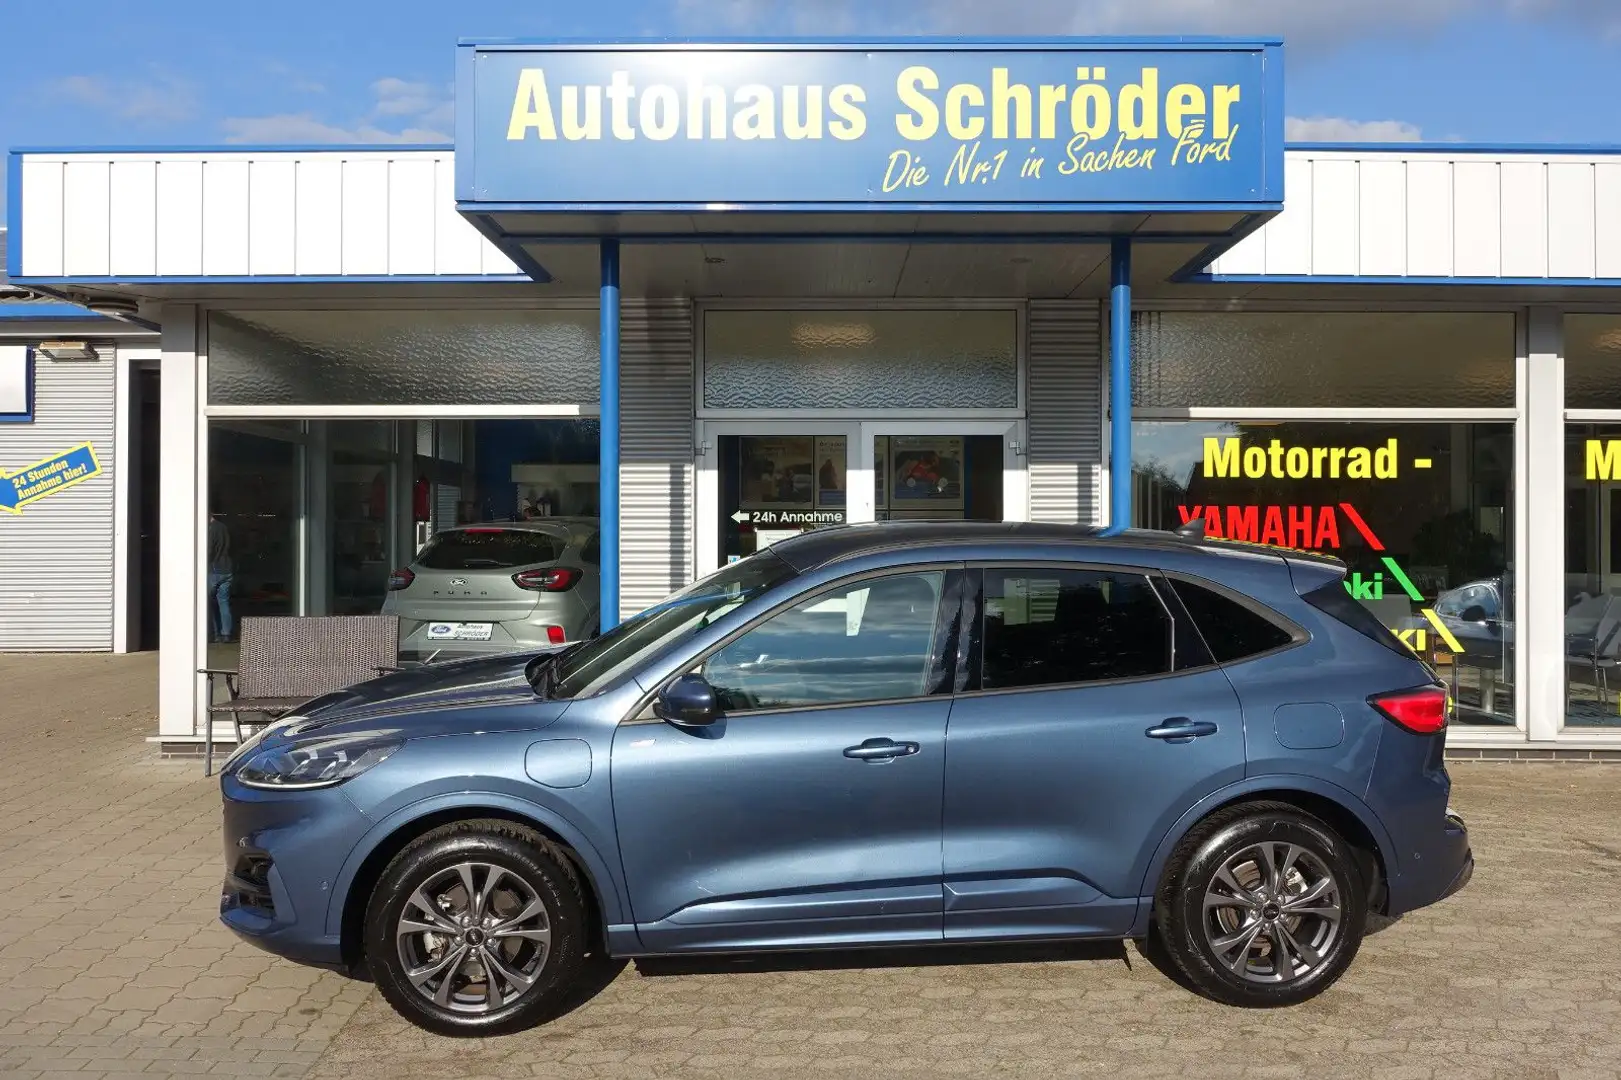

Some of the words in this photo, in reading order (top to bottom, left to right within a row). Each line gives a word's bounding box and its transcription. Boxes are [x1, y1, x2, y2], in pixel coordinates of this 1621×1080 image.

[507, 67, 867, 142] Autohaus
[895, 67, 1241, 140] Schröder
[882, 149, 929, 192] Die
[944, 141, 1008, 186] Nr.1
[1020, 147, 1044, 179] in
[1057, 132, 1156, 175] Sachen
[1171, 119, 1239, 166] Ford
[12, 475, 27, 488] 24
[27, 460, 69, 483] Stunden
[1203, 438, 1398, 479] Motorrad
[17, 475, 63, 500] Annahme
[62, 463, 88, 481] hier!
[752, 510, 777, 523] 24h
[780, 510, 843, 523] Annahme
